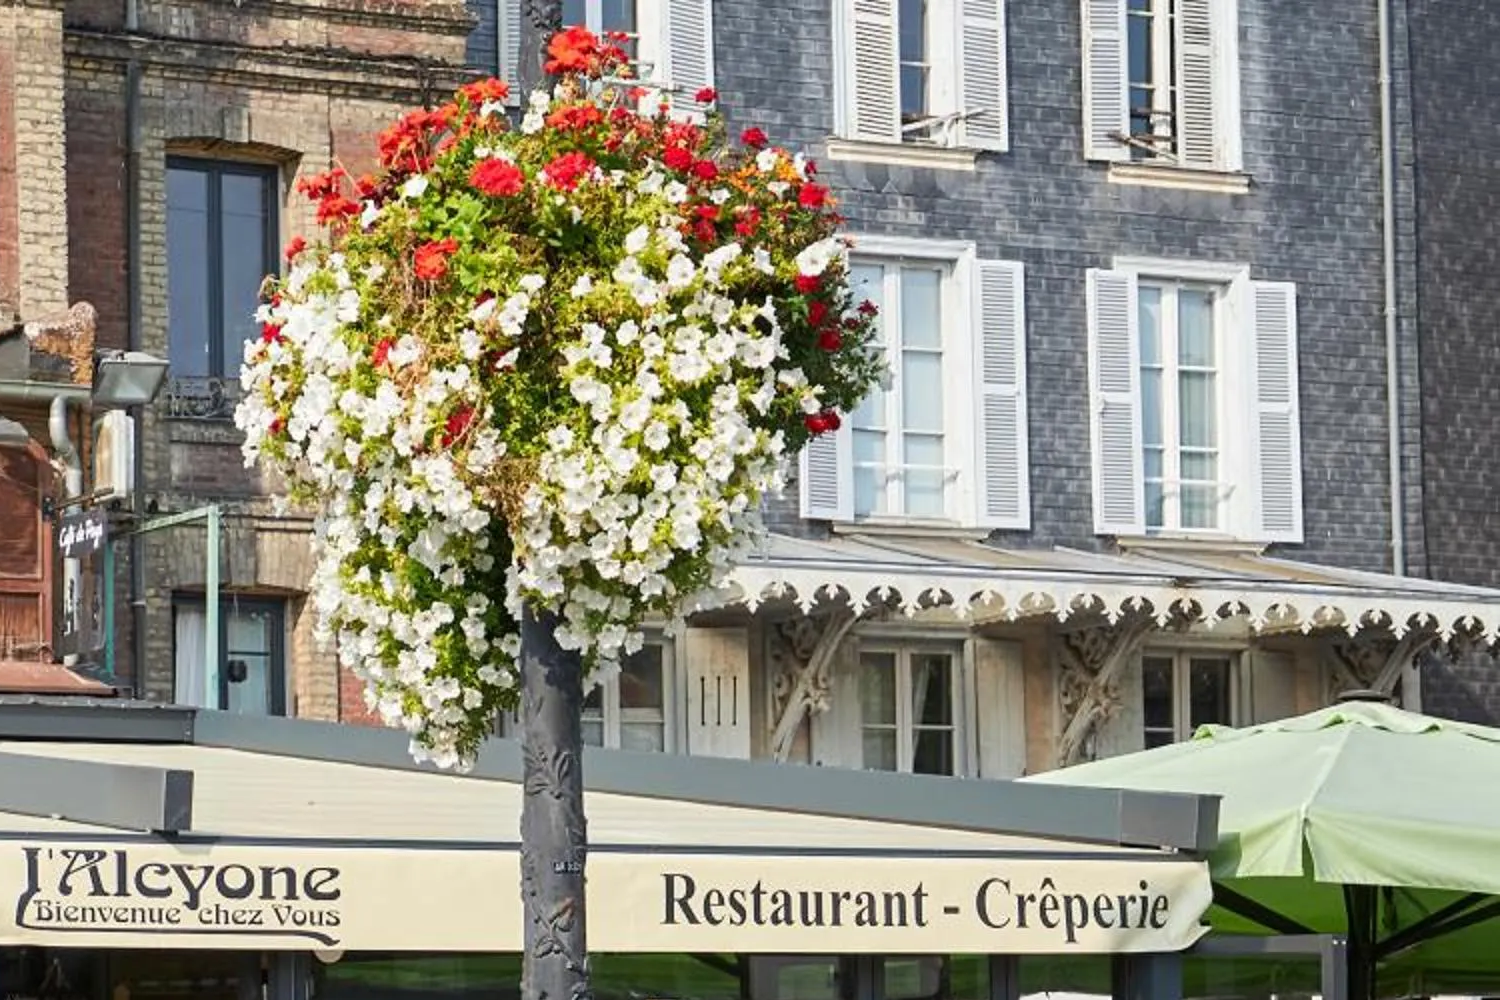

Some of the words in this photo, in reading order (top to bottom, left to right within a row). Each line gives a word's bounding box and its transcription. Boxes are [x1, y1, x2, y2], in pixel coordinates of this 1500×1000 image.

[33, 899, 182, 924] Bienvenue
[197, 902, 263, 927] chez
[274, 903, 342, 928] Vous
[659, 872, 930, 930] Restaurant
[975, 876, 1170, 943] Crêperie
